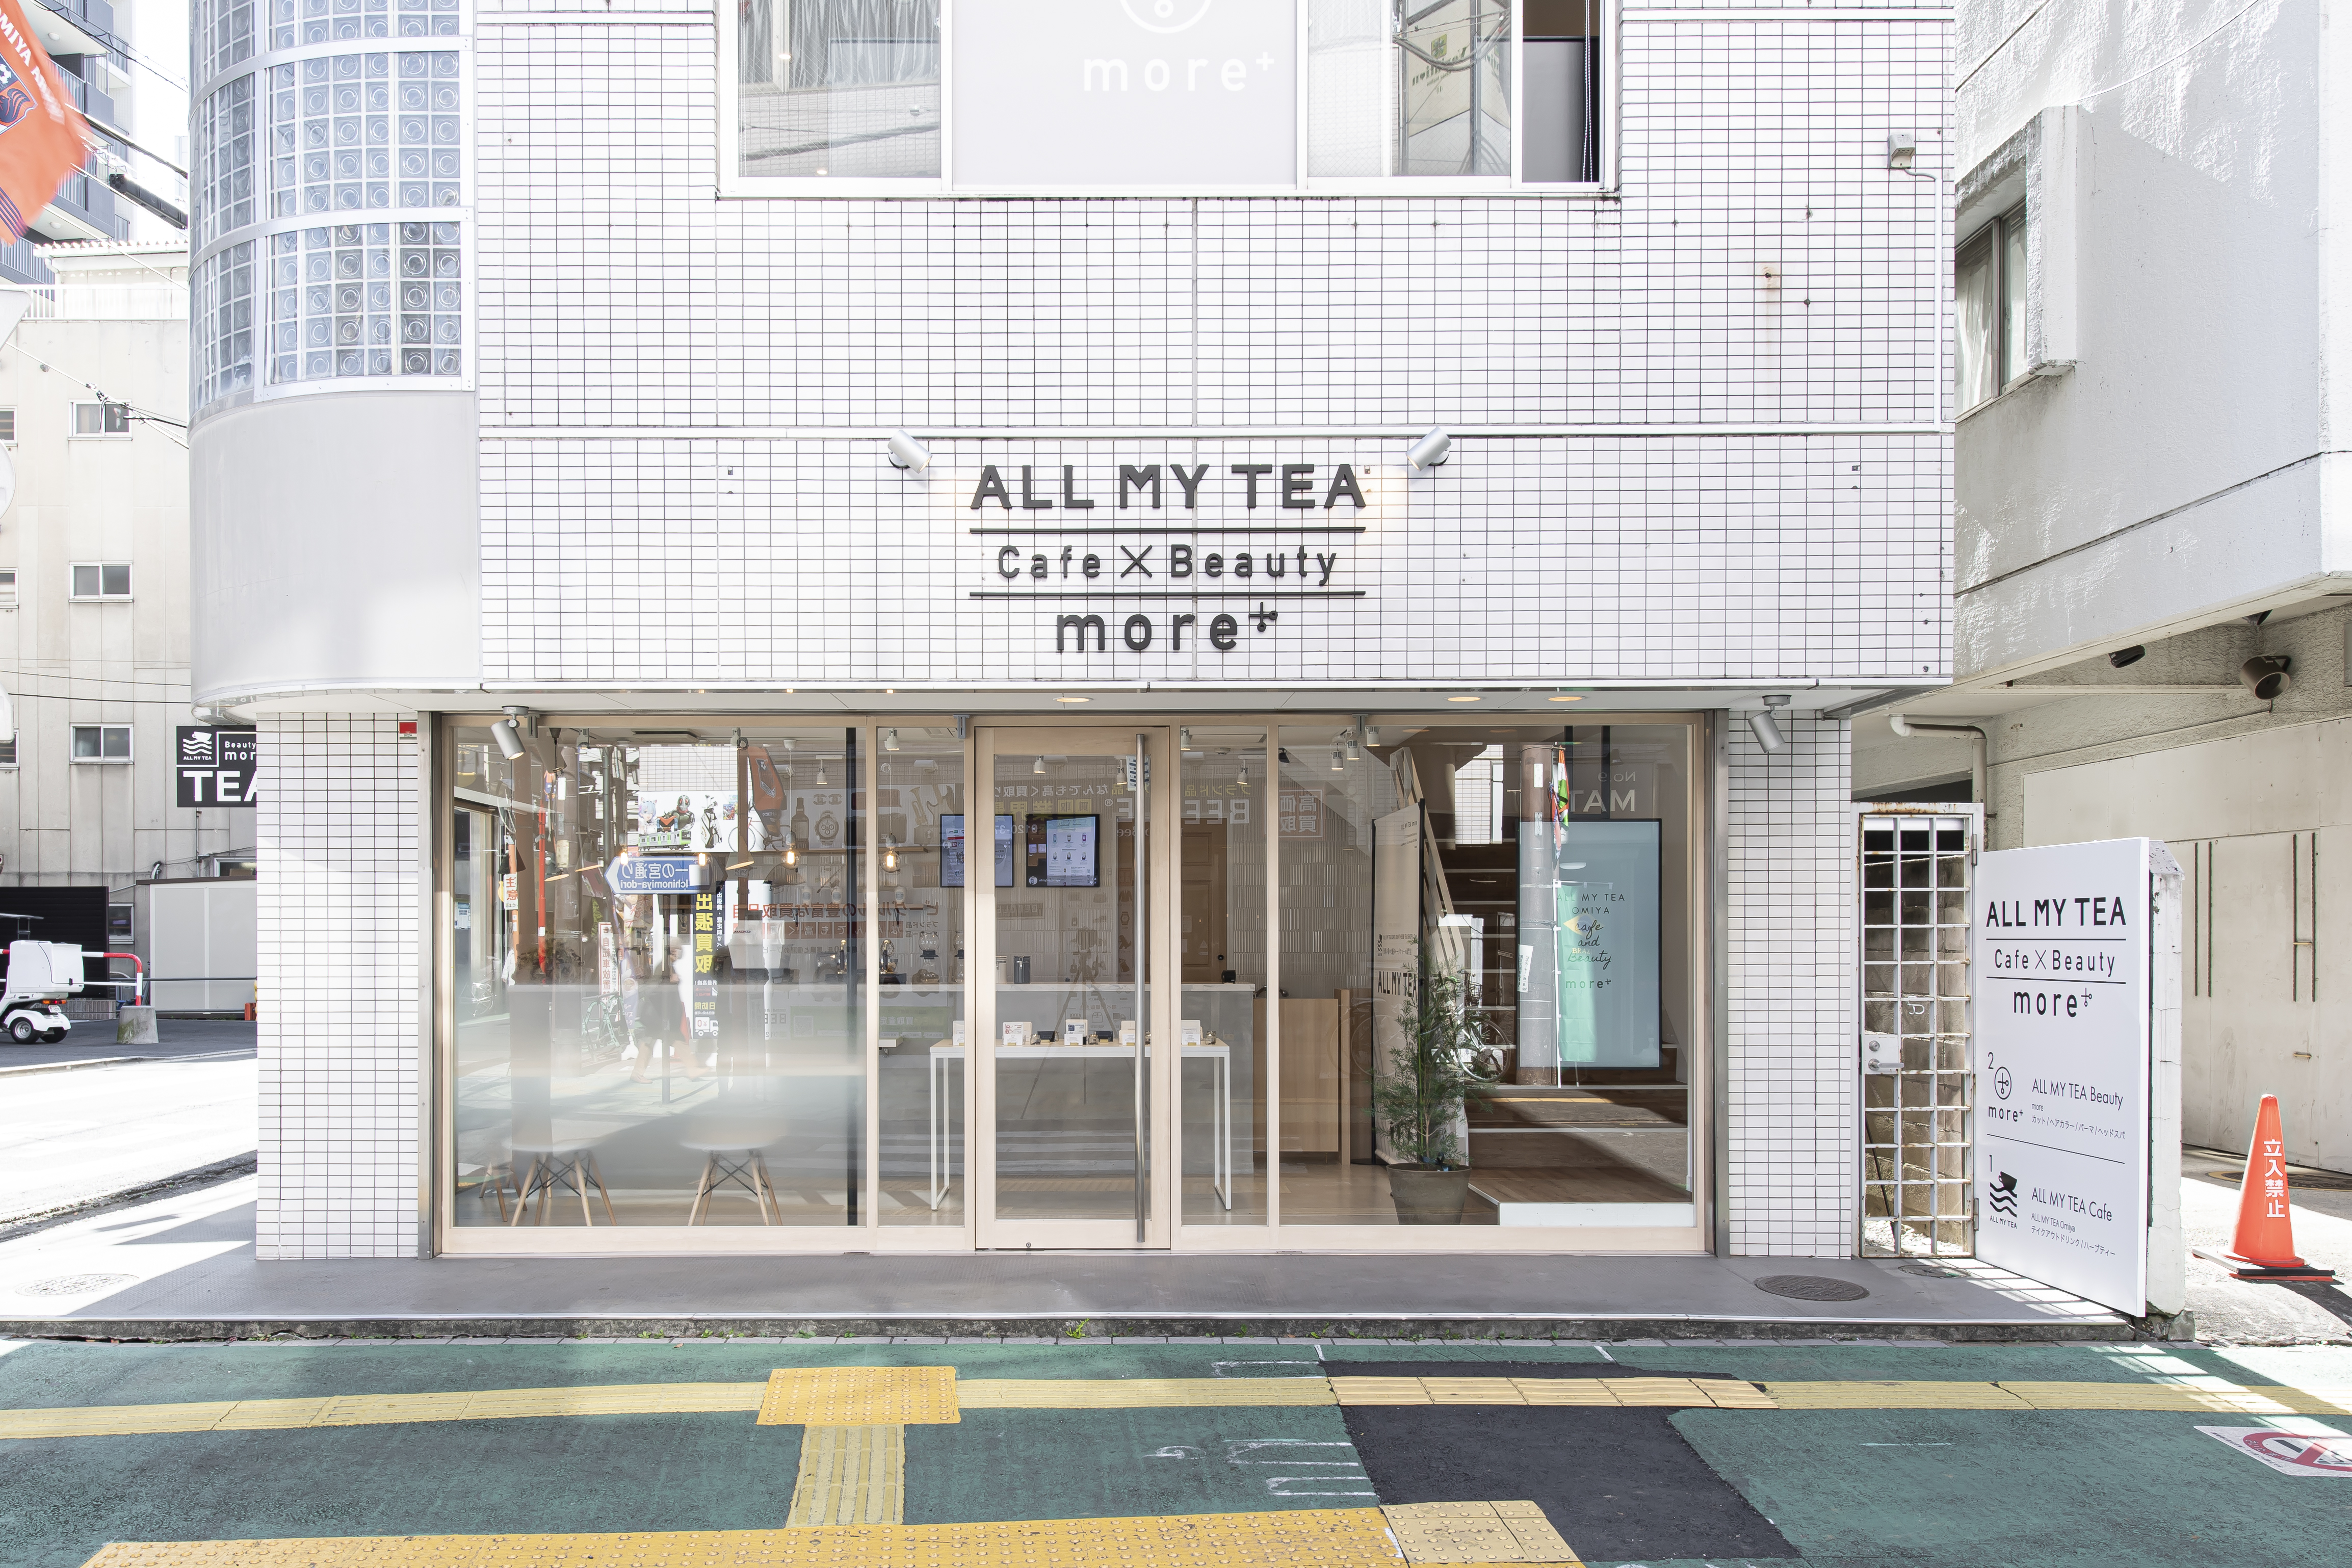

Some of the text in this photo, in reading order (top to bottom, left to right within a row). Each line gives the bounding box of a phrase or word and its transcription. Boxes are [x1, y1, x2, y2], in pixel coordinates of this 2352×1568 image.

[0, 7, 32, 67] MIYA
[971, 463, 1367, 509] ALL MY TEA
[998, 545, 1101, 579] Cafe
[1171, 544, 1337, 586] Beauty
[224, 741, 256, 750] Beauty
[1582, 893, 1598, 902] MY
[1604, 893, 1626, 902] TEA
[1572, 907, 1610, 915] OMIYA
[1986, 896, 2126, 927] ALL MY TEA
[1578, 935, 1601, 949] and
[1567, 950, 1612, 970] Beauty
[1995, 949, 2029, 970] Cafe
[2052, 949, 2115, 978] Beauty
[1377, 970, 1391, 995] ALL
[1392, 972, 1401, 996] MY
[1987, 1052, 1994, 1070] 2
[2031, 1078, 2124, 1111] ALL MY TEA Beauty
[2031, 1103, 2044, 1111] more
[2262, 1139, 2287, 1219] 立入禁止
[2031, 1187, 2113, 1222] ALL MY TEA Cafe
[2007, 1220, 2018, 1230] TEA
[2031, 1213, 2041, 1222] ALL
[2049, 1217, 2060, 1227] TEA
[2060, 1220, 2076, 1234] Omiya
